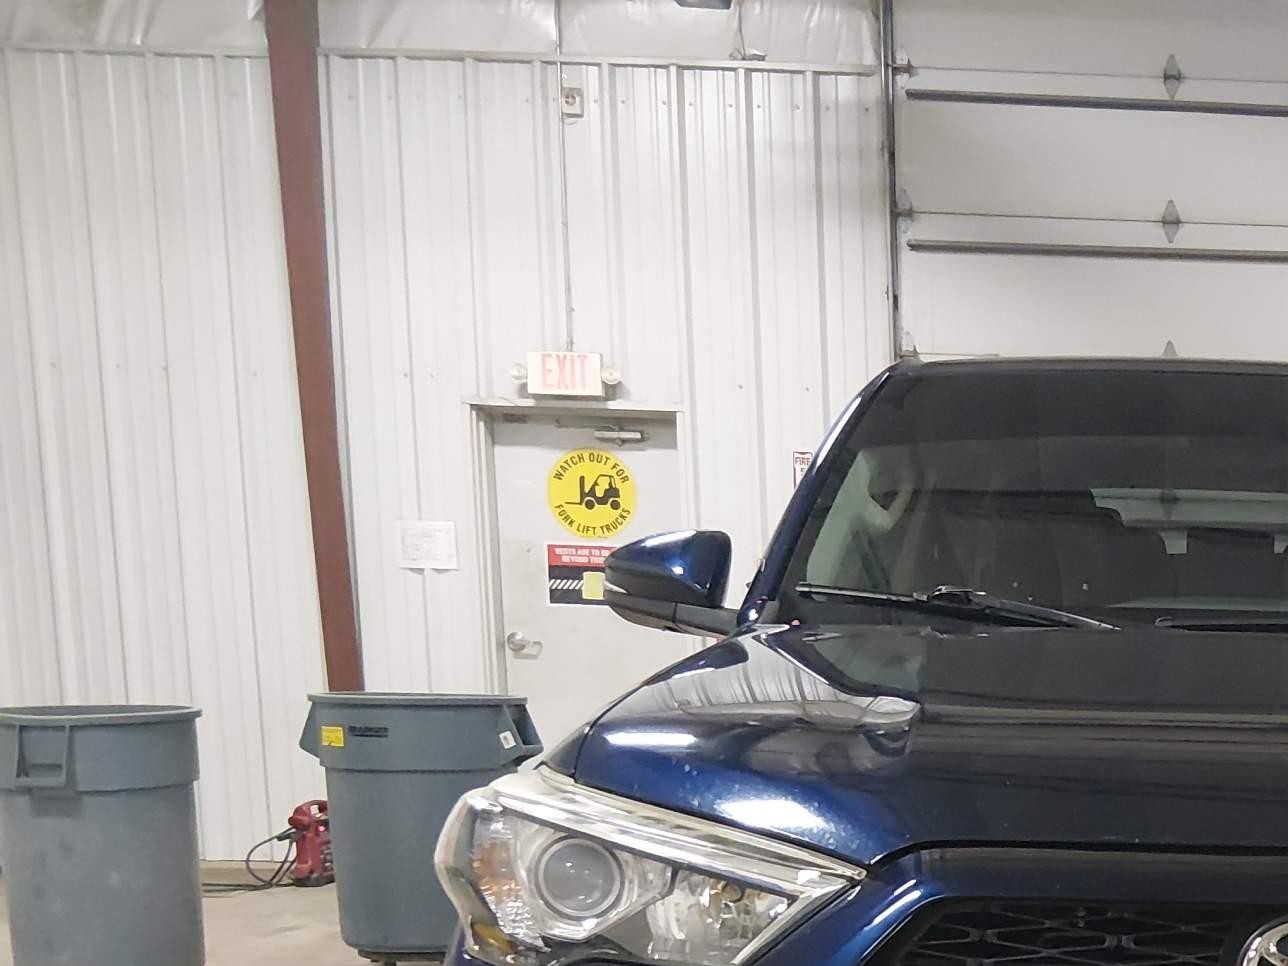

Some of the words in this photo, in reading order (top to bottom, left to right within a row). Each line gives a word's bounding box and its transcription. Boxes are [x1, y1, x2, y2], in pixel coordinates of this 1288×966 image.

[541, 353, 588, 389] EXIT
[553, 453, 585, 480] WATCH
[588, 452, 611, 466] OUT
[610, 463, 629, 483] FOR
[555, 504, 576, 528] FORK
[576, 523, 597, 536] LIFT
[600, 508, 631, 535] TRUCKS
